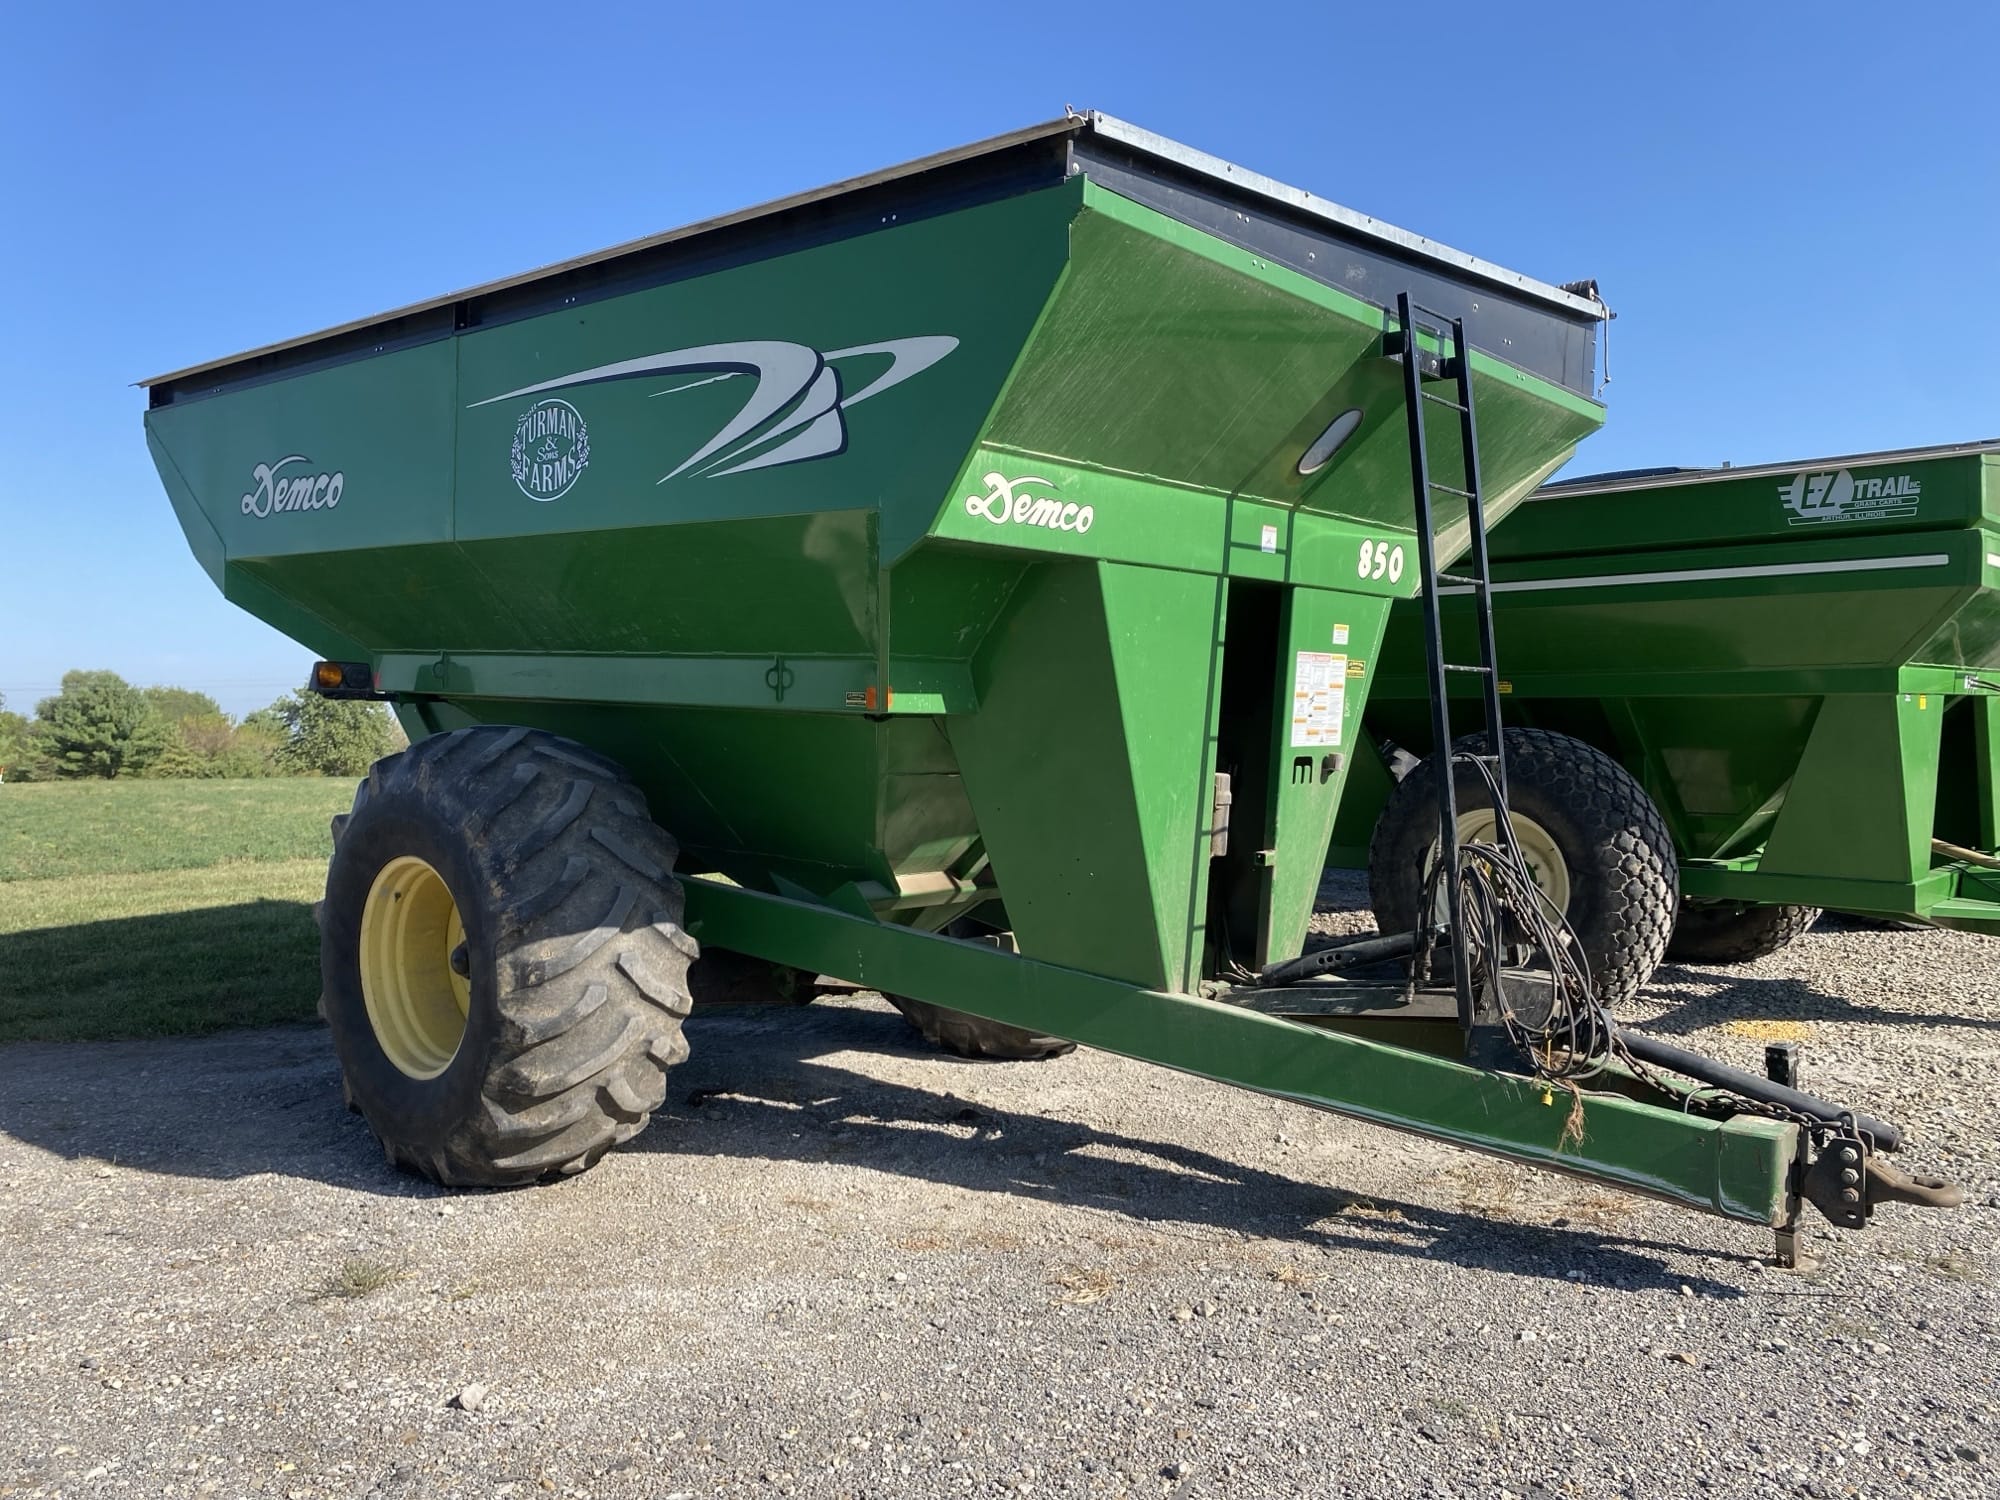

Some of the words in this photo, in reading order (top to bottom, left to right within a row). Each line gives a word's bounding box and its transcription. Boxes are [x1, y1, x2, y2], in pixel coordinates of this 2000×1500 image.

[520, 407, 576, 451] TURMAN
[545, 436, 558, 451] &
[241, 454, 345, 519] Demco
[522, 446, 576, 492] FARMS
[1854, 475, 1921, 499] TRAIL
[965, 471, 1094, 534] Demco
[1854, 500, 1877, 508] GRAIN
[1879, 497, 1903, 505] CARTS
[1855, 511, 1886, 520] ILLINOIS
[1357, 538, 1404, 584] 850
